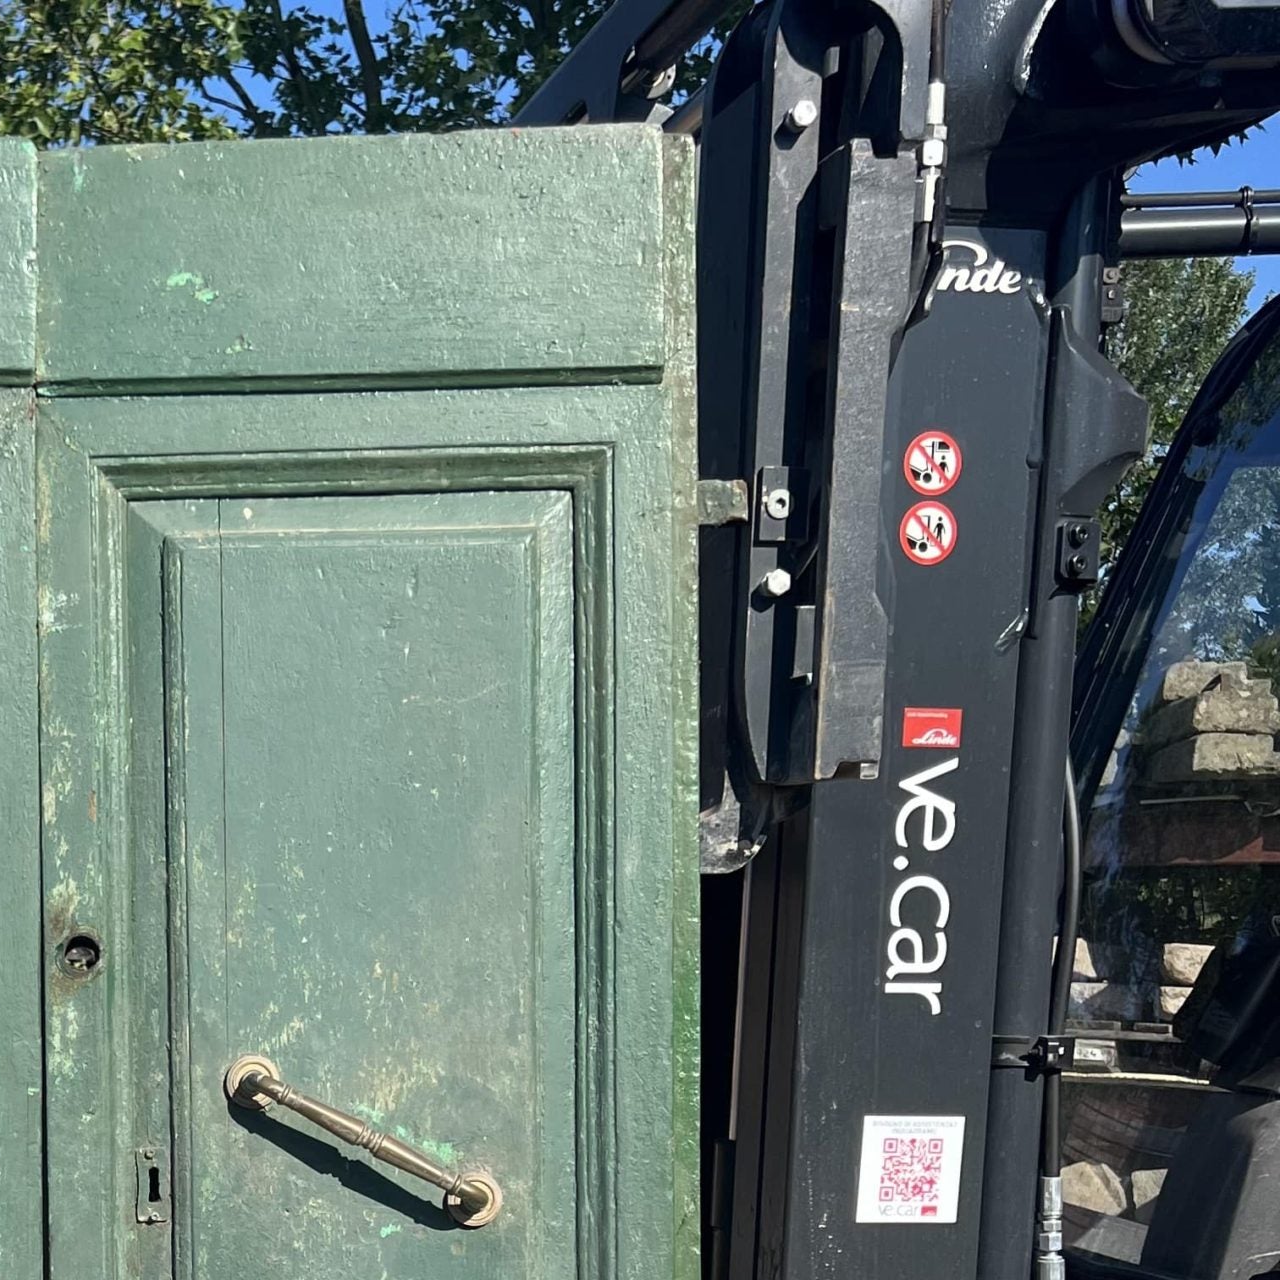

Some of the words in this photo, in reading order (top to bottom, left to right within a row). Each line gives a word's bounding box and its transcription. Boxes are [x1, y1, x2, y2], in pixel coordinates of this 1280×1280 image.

[936, 240, 1022, 294] nde
[884, 757, 960, 1016] ve.car
[878, 1204, 919, 1217] ve.car
